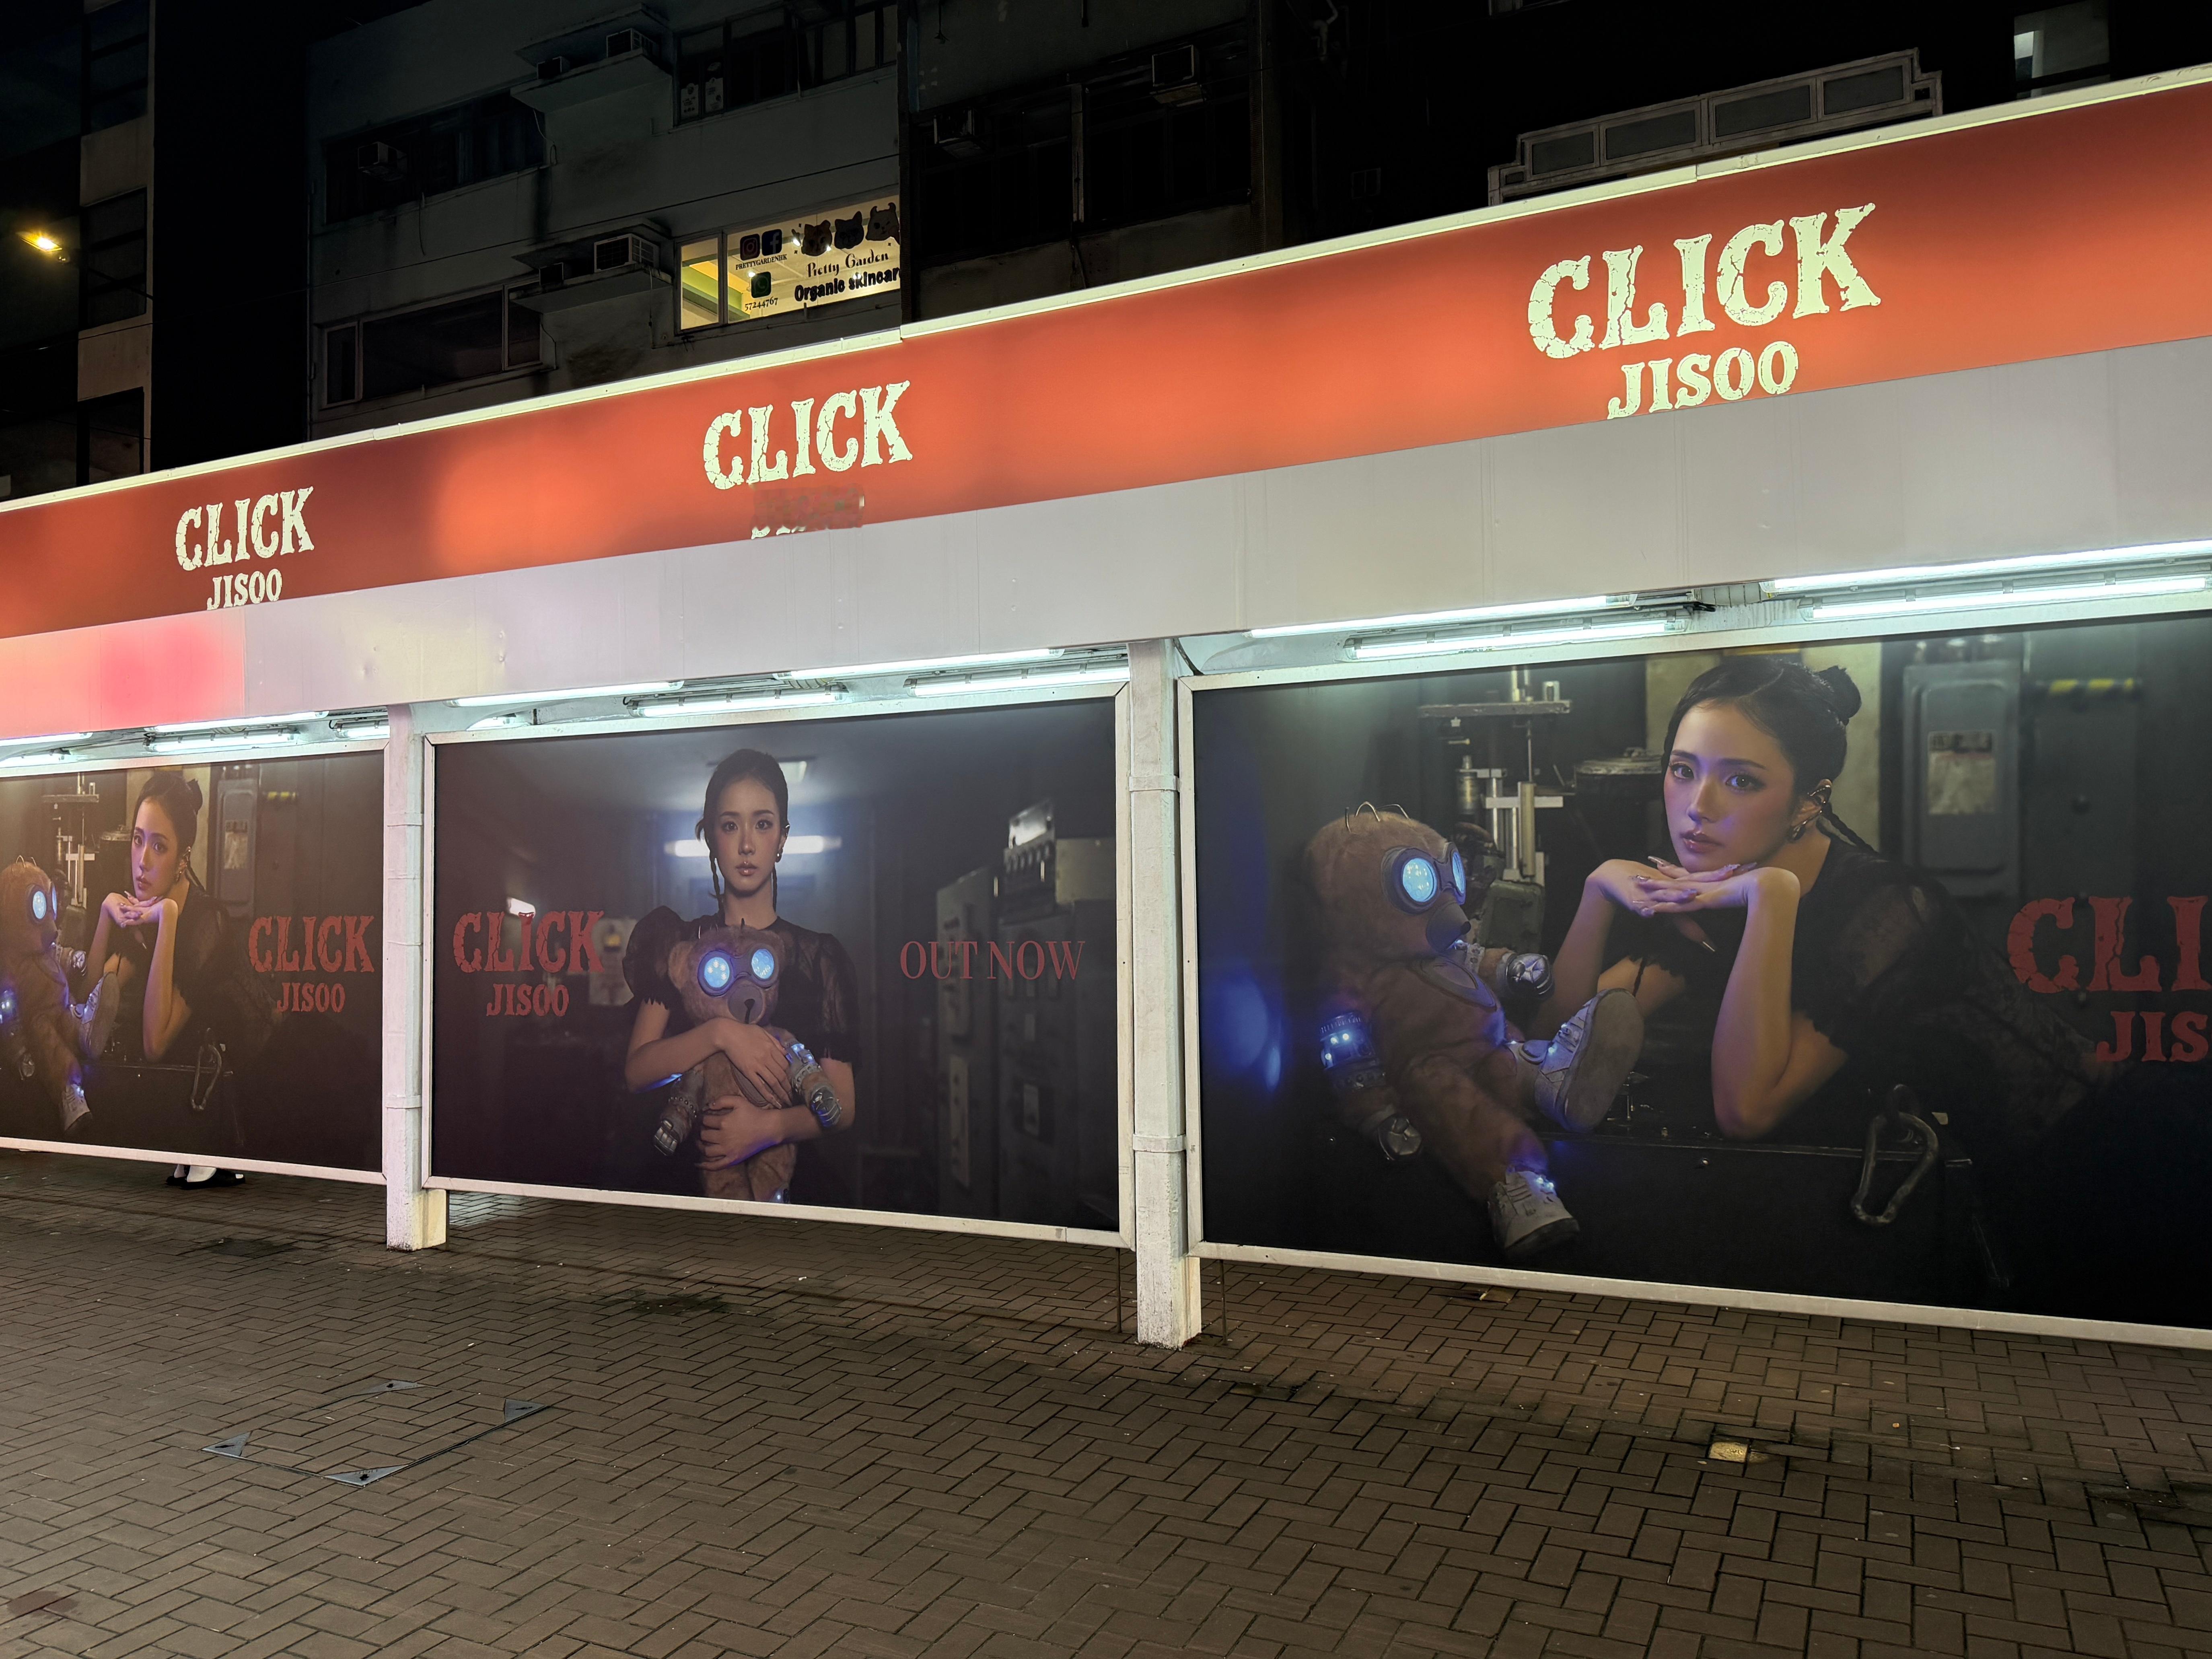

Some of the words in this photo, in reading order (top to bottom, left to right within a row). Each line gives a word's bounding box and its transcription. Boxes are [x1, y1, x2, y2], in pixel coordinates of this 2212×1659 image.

[736, 254, 788, 270] PRETTYGARDENHK
[807, 262, 840, 278] Pretty
[845, 249, 889, 268] Garden
[1528, 202, 1881, 359] CLICK
[745, 296, 778, 311] 57244767
[794, 278, 846, 301] Organic
[849, 267, 901, 290] skincar
[1607, 341, 1799, 420] JISOO
[703, 380, 913, 490] CLICK
[175, 486, 315, 571] CLICK
[207, 568, 282, 611] JISOO
[249, 915, 375, 972] CLICK
[453, 911, 604, 973] CLICK
[900, 941, 978, 979] OUT
[987, 941, 1085, 980] NOW
[276, 982, 345, 1013] JISOO
[486, 983, 570, 1017] JISOO
[2096, 1011, 2212, 1062] JIS
